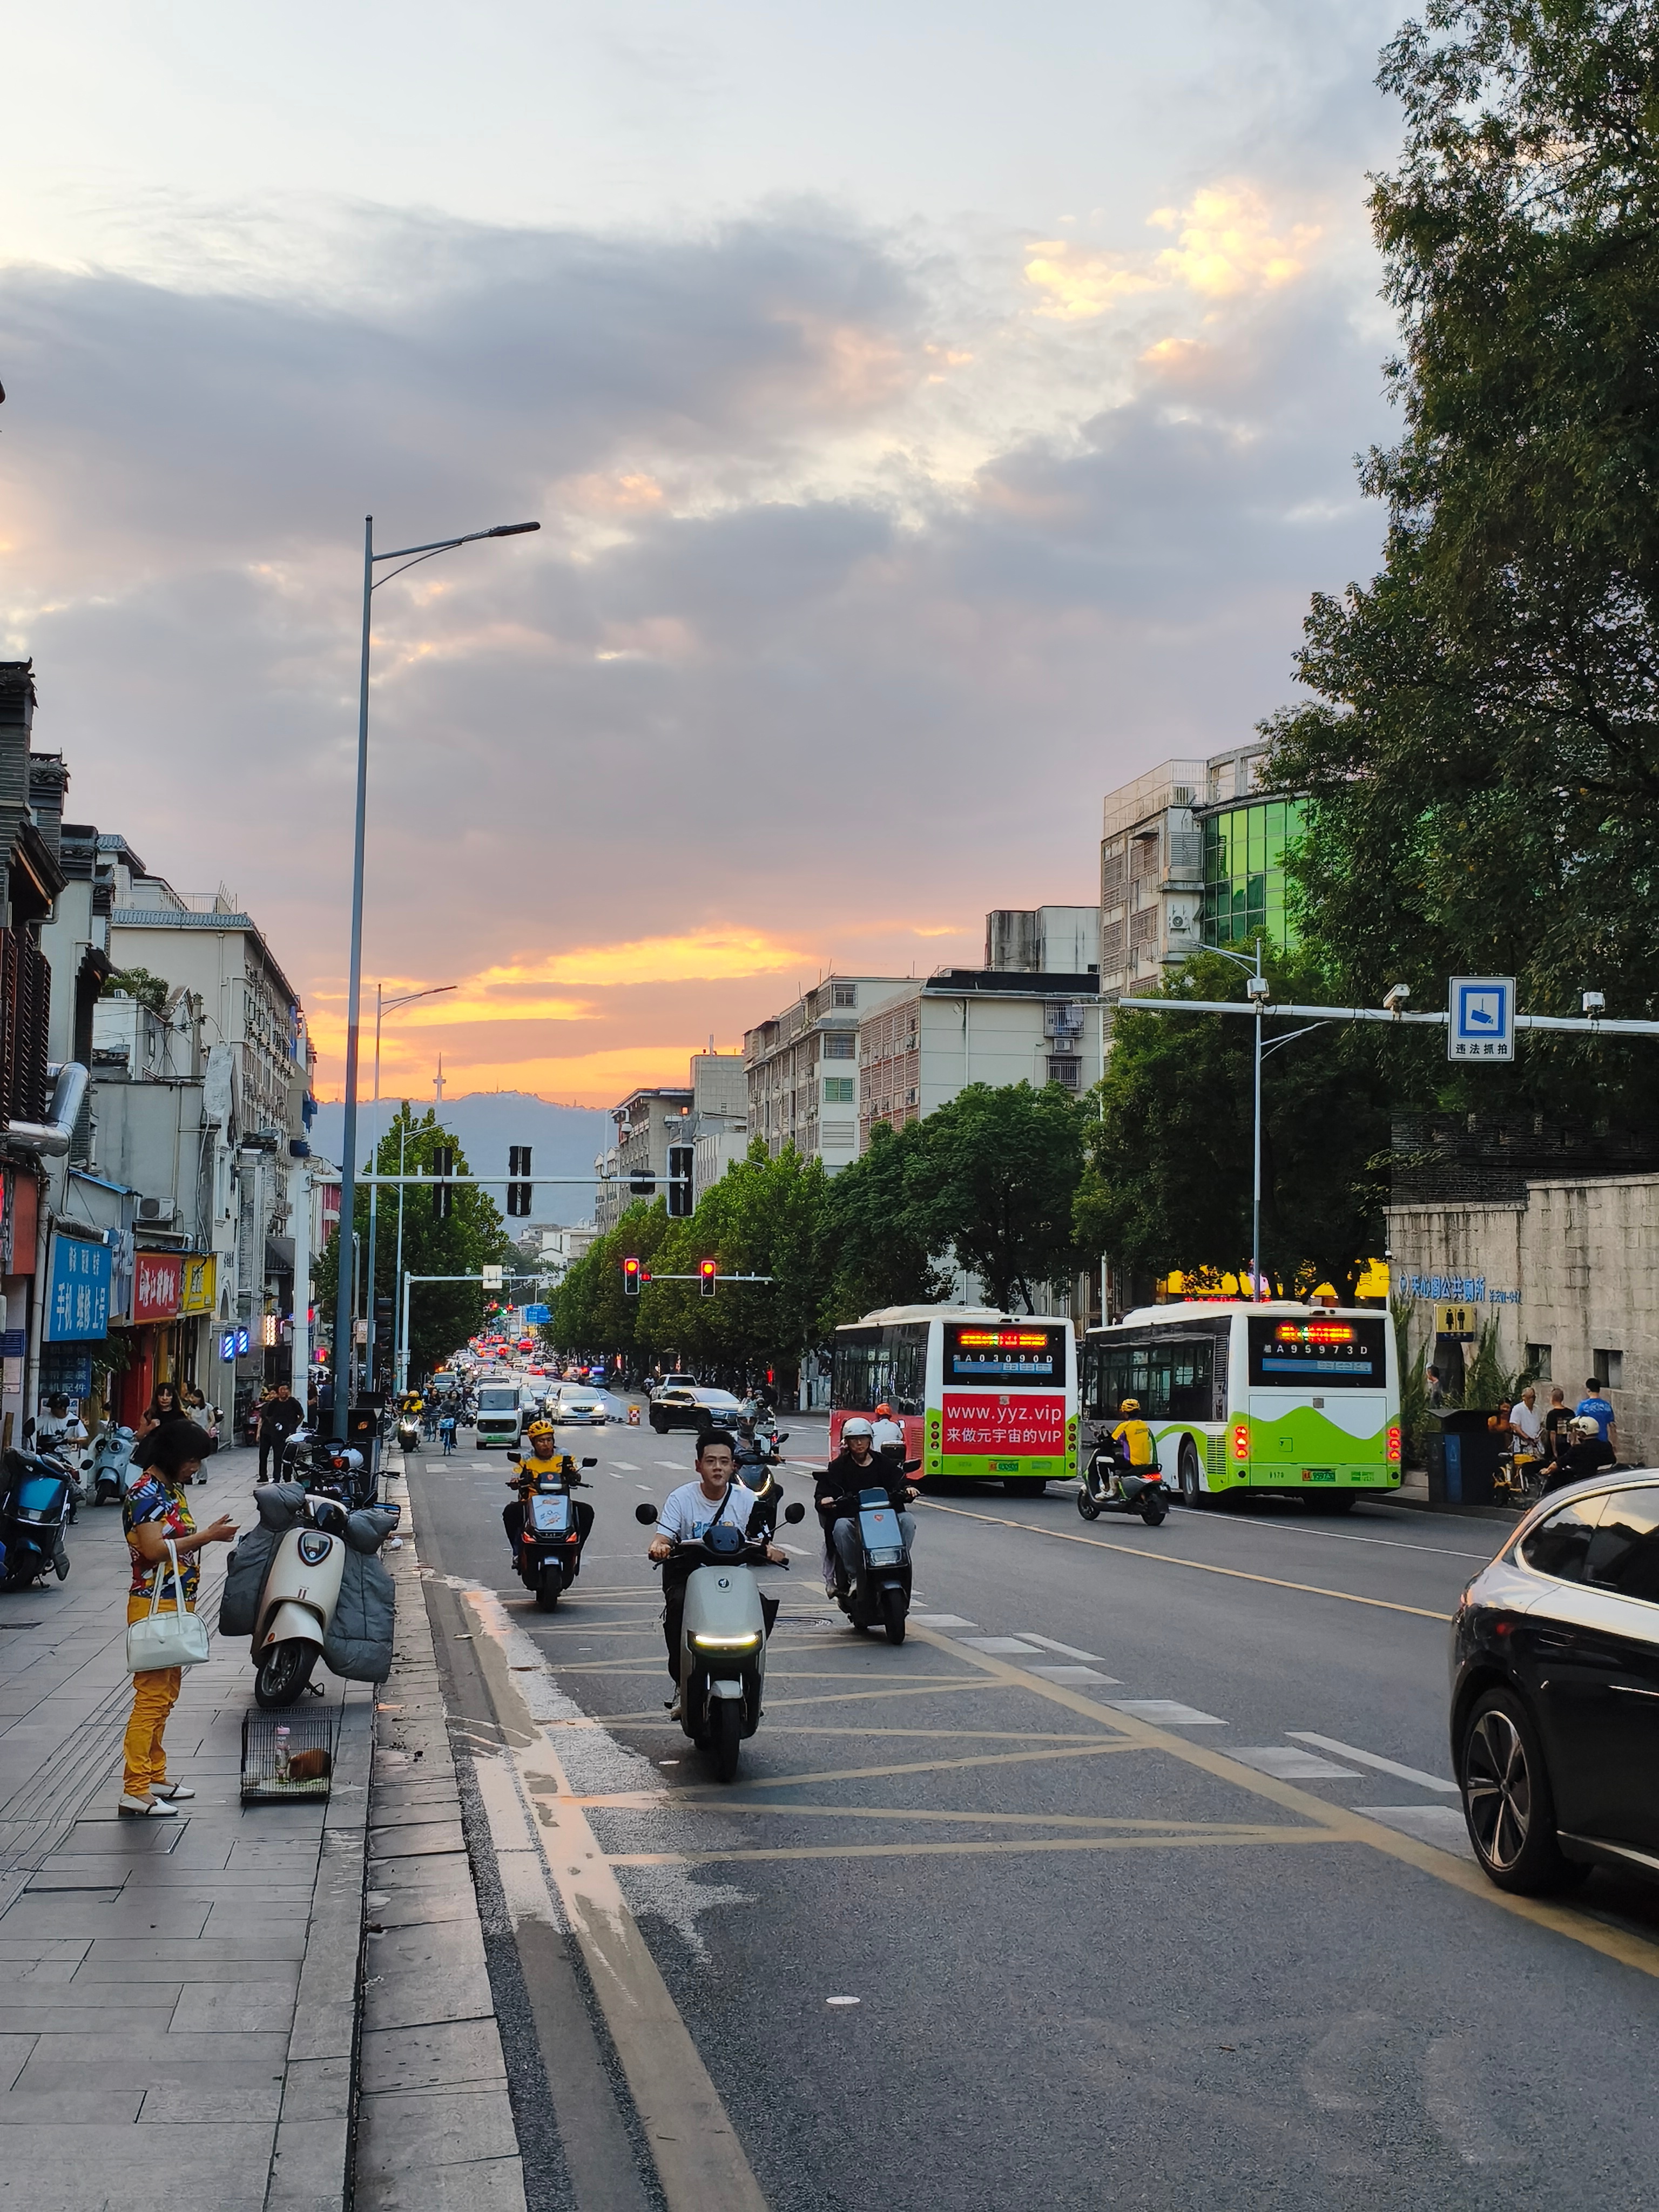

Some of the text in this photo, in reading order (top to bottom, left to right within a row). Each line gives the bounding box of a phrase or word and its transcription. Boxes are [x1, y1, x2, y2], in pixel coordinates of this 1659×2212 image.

[1455, 1043, 1508, 1055] 违法抓拍
[947, 1404, 1062, 1425] www.yyz.vip
[947, 1427, 1062, 1444] 来做元宇宙的VIP
